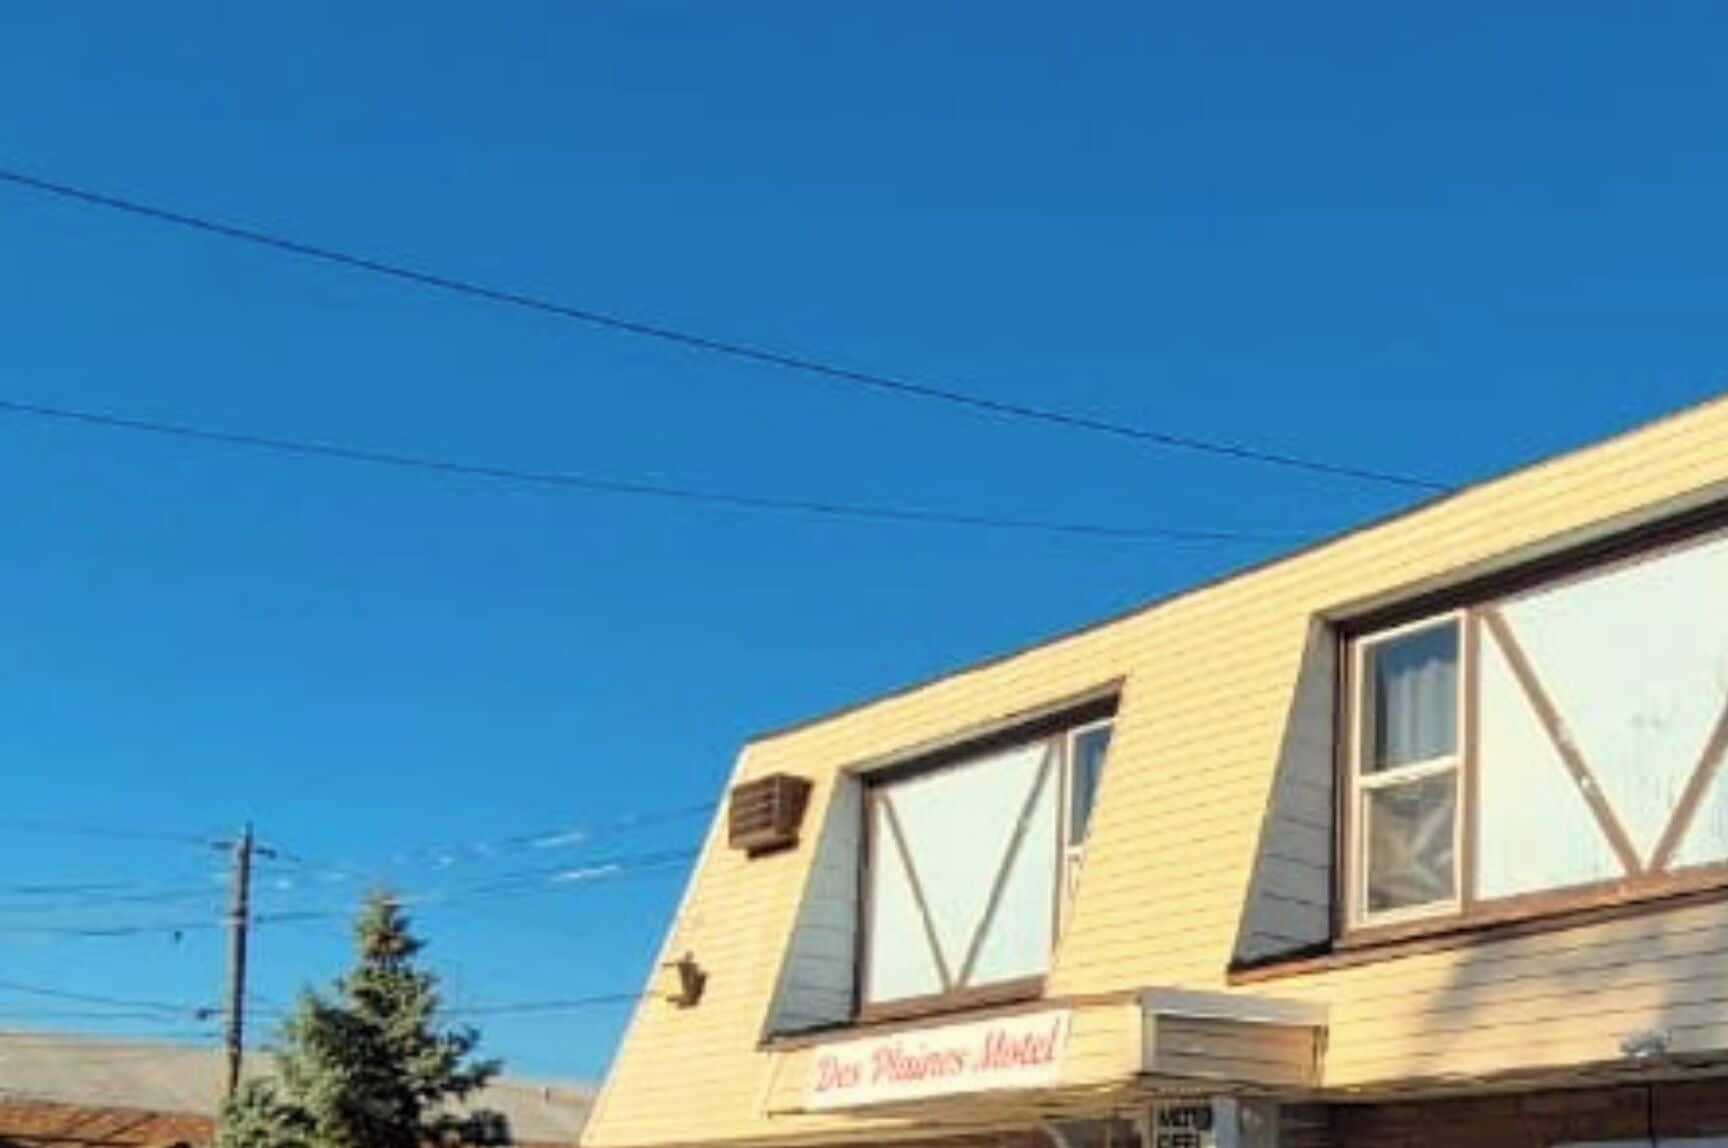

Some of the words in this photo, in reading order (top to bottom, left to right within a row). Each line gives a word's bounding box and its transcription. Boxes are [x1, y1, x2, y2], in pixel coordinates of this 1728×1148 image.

[815, 1054, 861, 1092] Des
[872, 1040, 967, 1085] Plaines
[973, 1014, 1061, 1072] Motel
